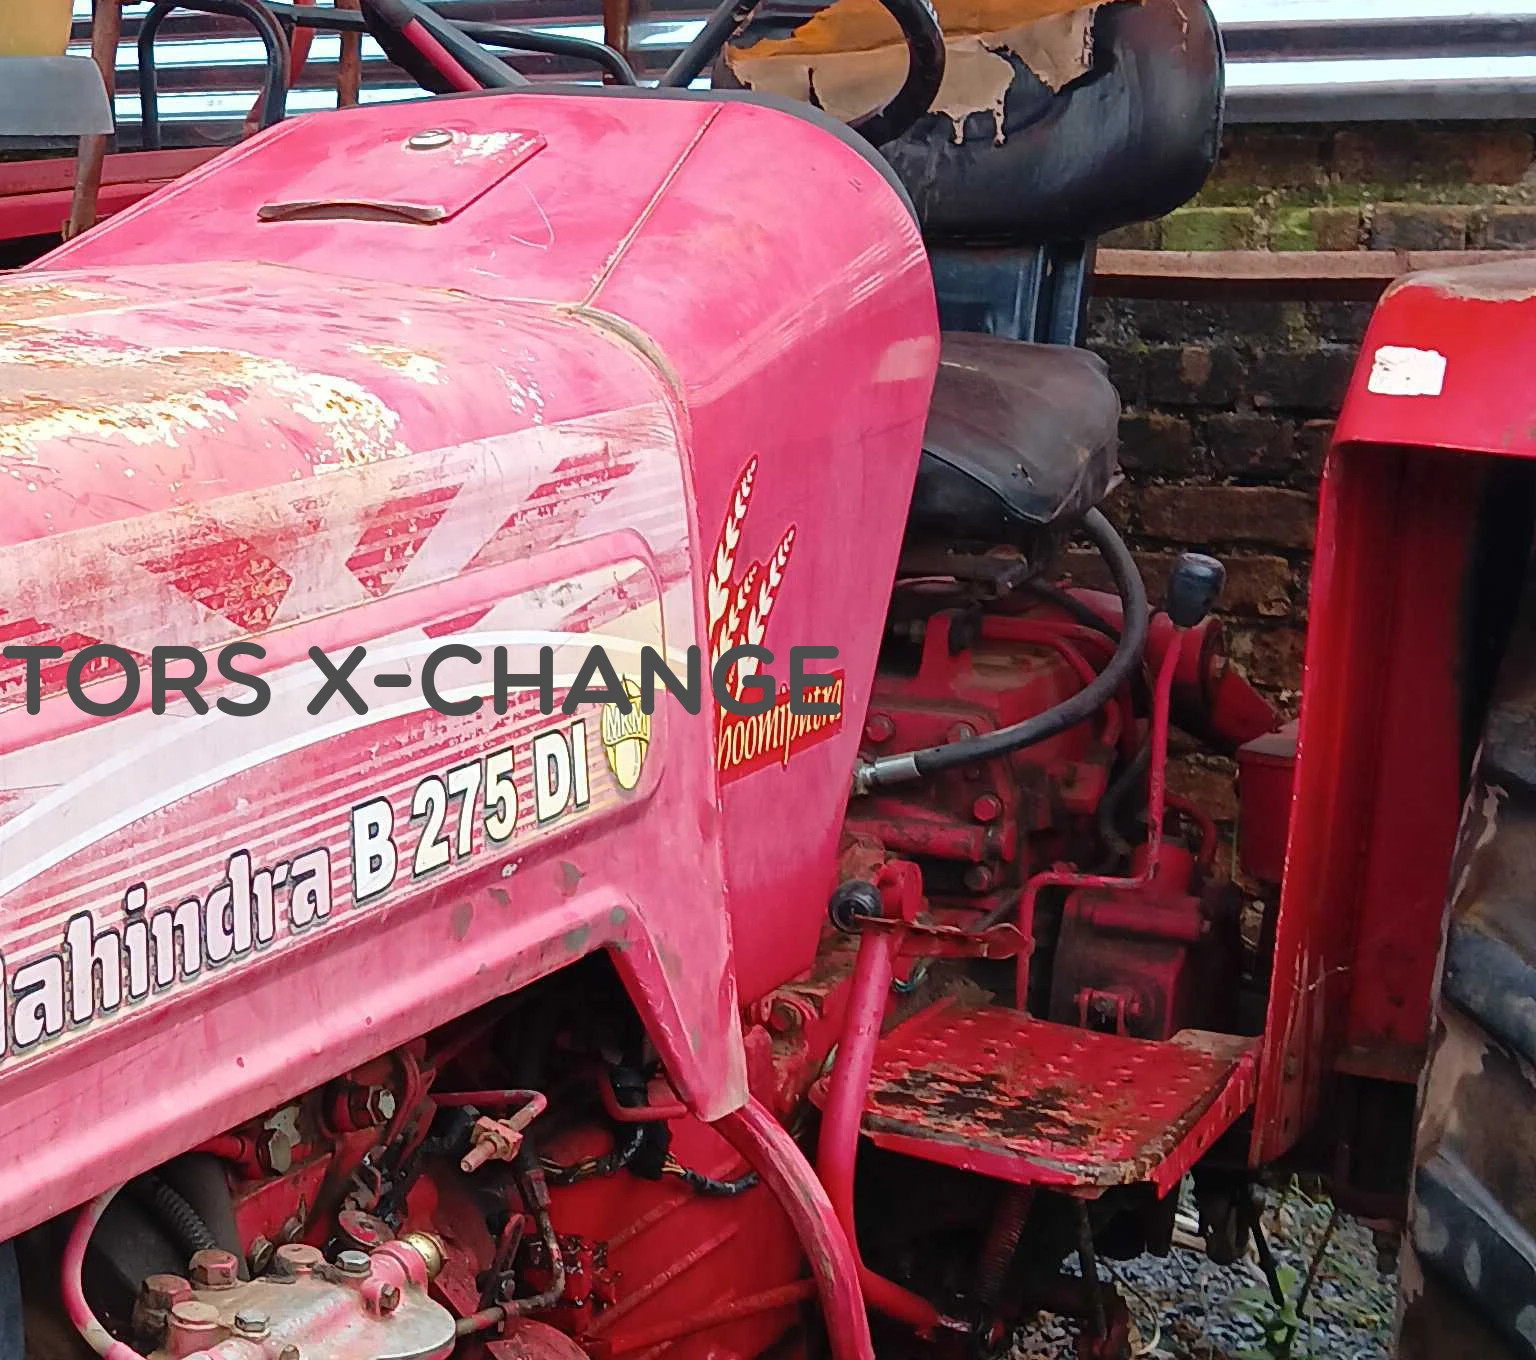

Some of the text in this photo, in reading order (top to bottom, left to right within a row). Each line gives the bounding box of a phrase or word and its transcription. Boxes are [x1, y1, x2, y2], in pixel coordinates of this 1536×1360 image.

[351, 796, 399, 903] B
[409, 745, 520, 879] 275
[533, 718, 591, 824] DI
